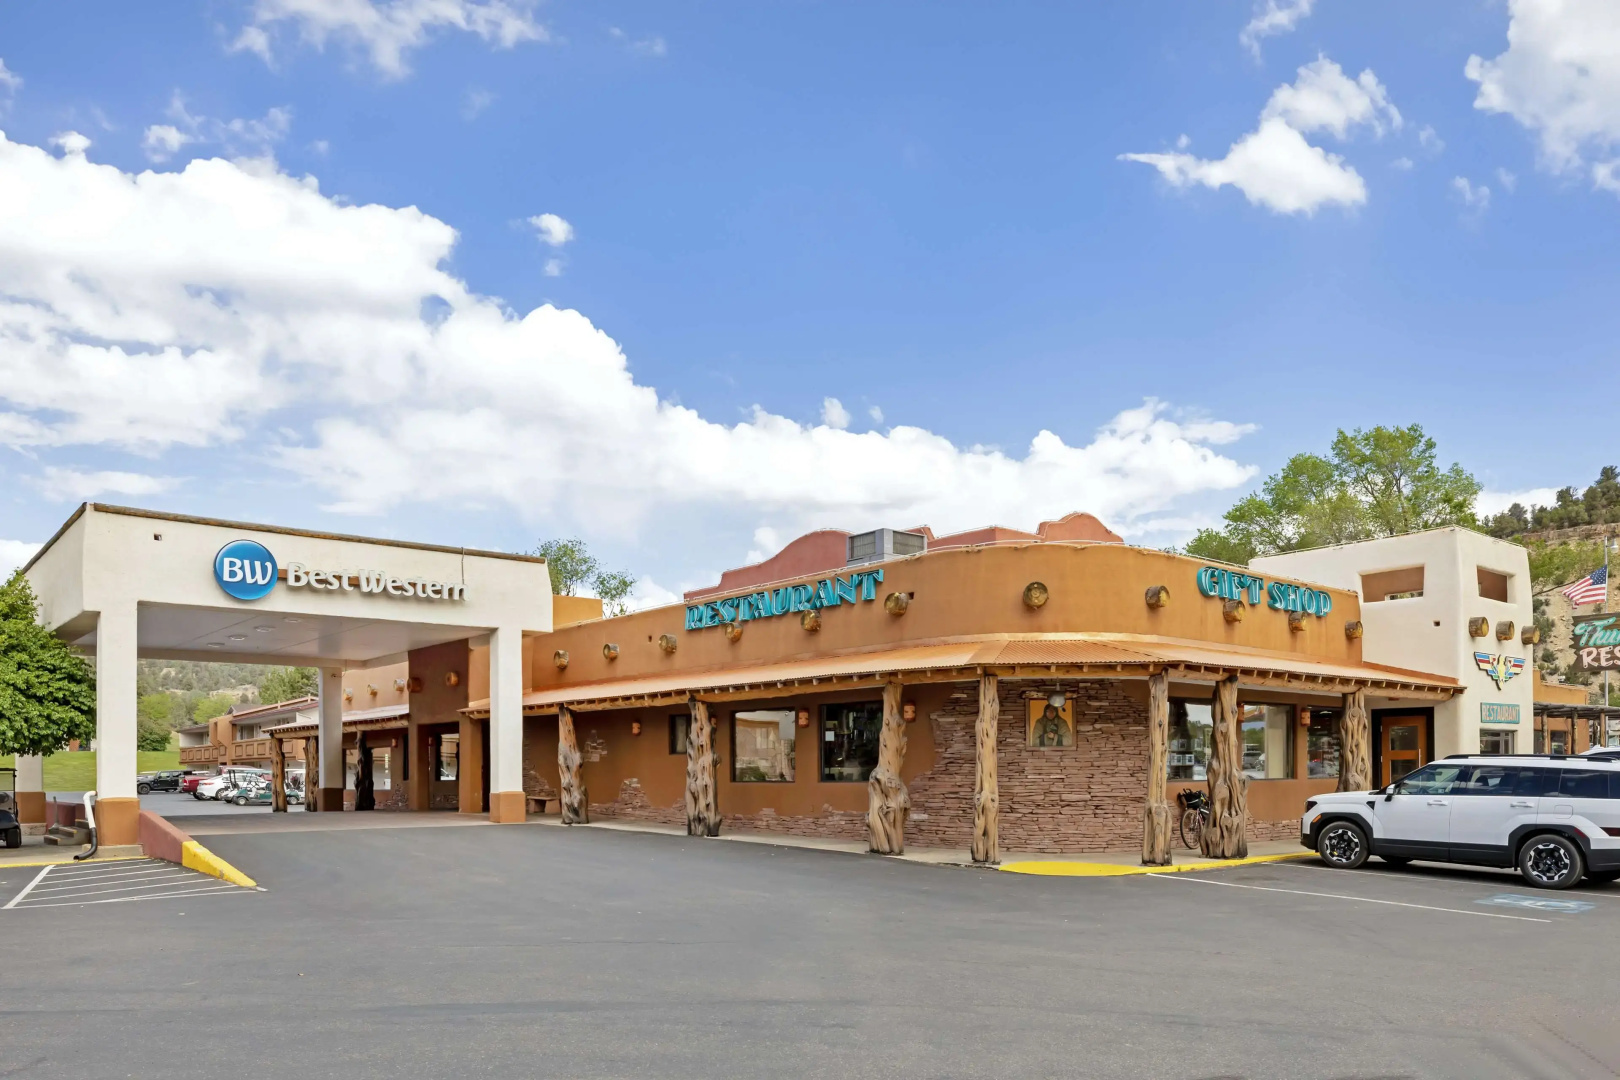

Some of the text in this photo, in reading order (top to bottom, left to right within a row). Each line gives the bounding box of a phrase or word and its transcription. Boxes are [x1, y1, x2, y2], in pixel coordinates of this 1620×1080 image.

[223, 557, 272, 585] BW
[286, 562, 470, 601] Best Western
[685, 569, 884, 631] RESTAURANT
[1197, 566, 1332, 617] GIFT SHOP
[1482, 704, 1519, 722] RESTAURANT
